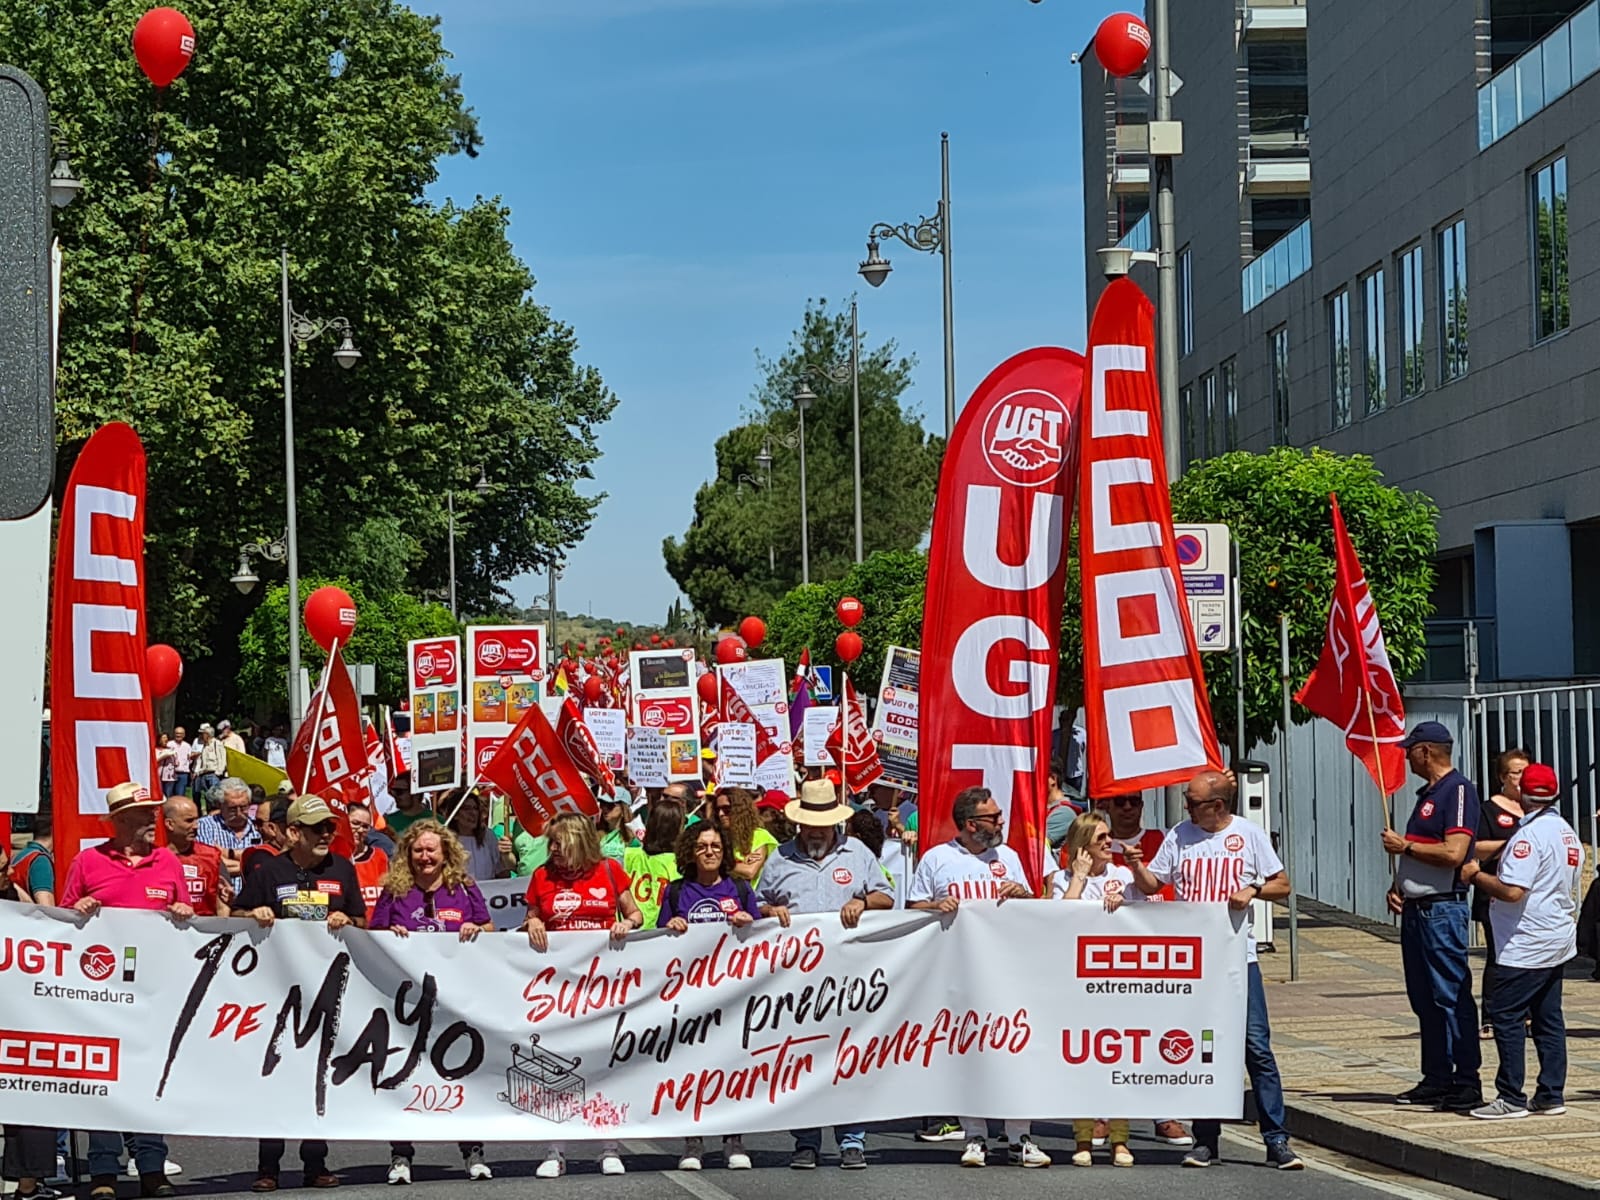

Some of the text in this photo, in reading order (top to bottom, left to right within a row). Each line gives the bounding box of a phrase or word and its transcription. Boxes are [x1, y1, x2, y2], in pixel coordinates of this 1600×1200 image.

[994, 404, 1063, 449] UGT
[1091, 344, 1208, 781] CCOO
[73, 484, 151, 850] CCO
[951, 484, 1064, 846] UGT
[1181, 858, 1244, 902] GANAS
[569, 920, 601, 928] LUCHA
[523, 927, 824, 1023] Subir salarios
[1085, 944, 1194, 970] CCOO
[33, 981, 135, 1004] Extremadura
[1086, 980, 1192, 994] extremadura
[209, 1002, 267, 1042] DE
[608, 968, 889, 1068] bajar precios
[0, 1038, 111, 1073] CCOO
[651, 1008, 1032, 1122] repartir beneficios
[1062, 1029, 1151, 1065] UGT
[0, 1077, 108, 1097] extremadura
[1111, 1071, 1214, 1085] Extremadura
[403, 1085, 464, 1113] 2023
